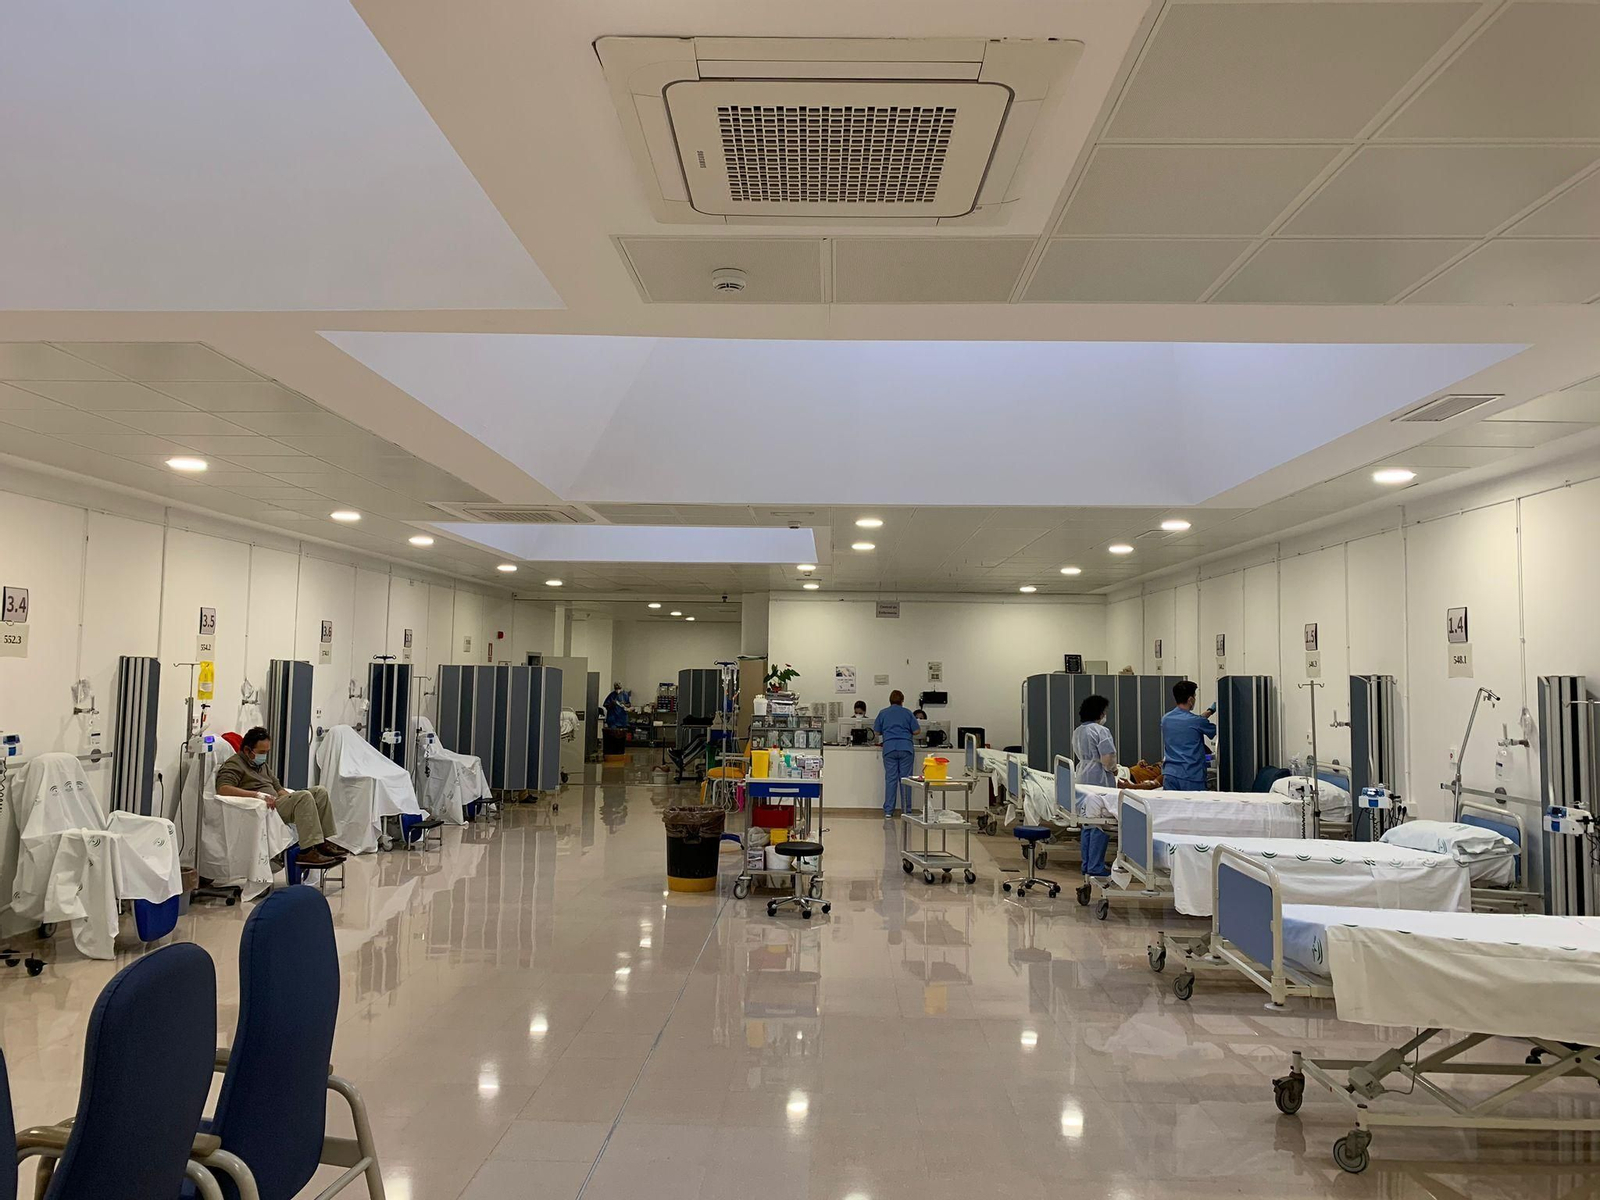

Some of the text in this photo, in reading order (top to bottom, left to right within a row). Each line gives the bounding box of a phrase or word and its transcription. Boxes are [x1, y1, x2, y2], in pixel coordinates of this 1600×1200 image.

[6, 595, 27, 613] 3.4
[202, 614, 215, 628] 3.5
[1448, 616, 1464, 634] 1.4
[3, 634, 22, 645] 552.3
[1305, 630, 1315, 643] 1.5
[1453, 655, 1467, 665] 548.1
